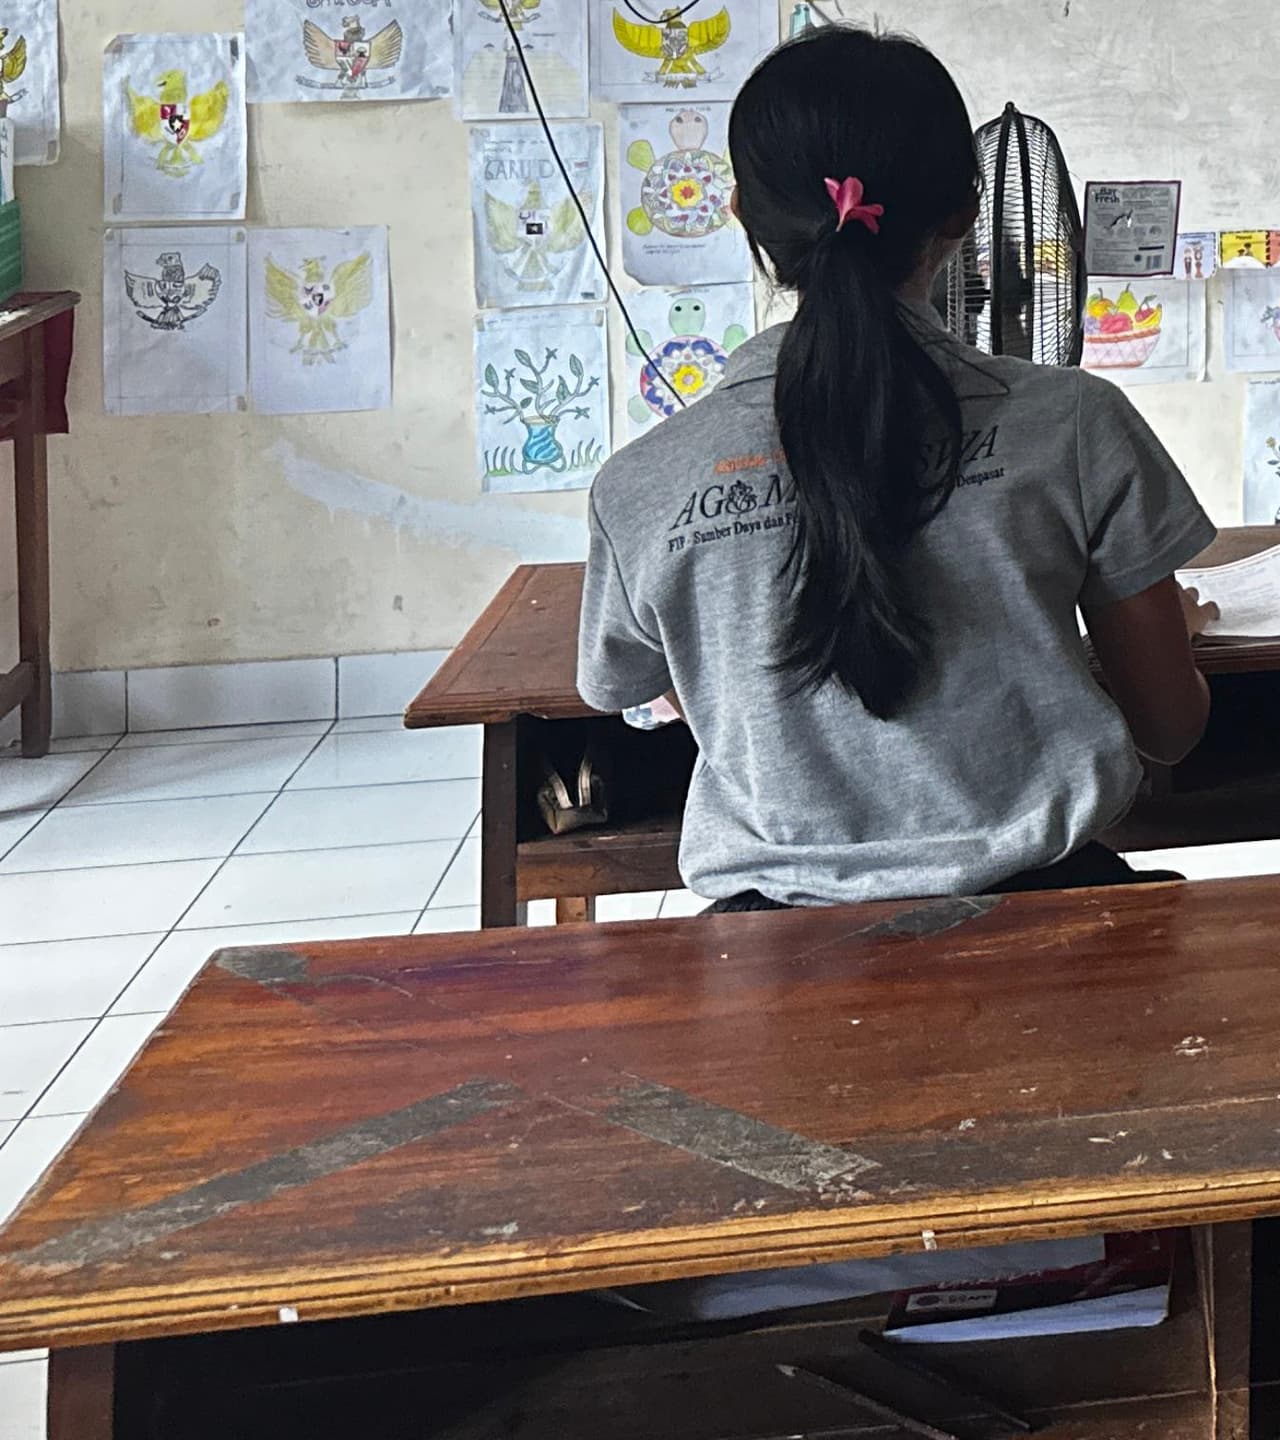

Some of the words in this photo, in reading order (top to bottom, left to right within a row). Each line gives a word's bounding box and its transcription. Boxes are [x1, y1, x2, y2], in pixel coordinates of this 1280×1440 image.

[693, 525, 732, 545] Sumber
[733, 519, 762, 536] Daya
[764, 516, 784, 530] dan
